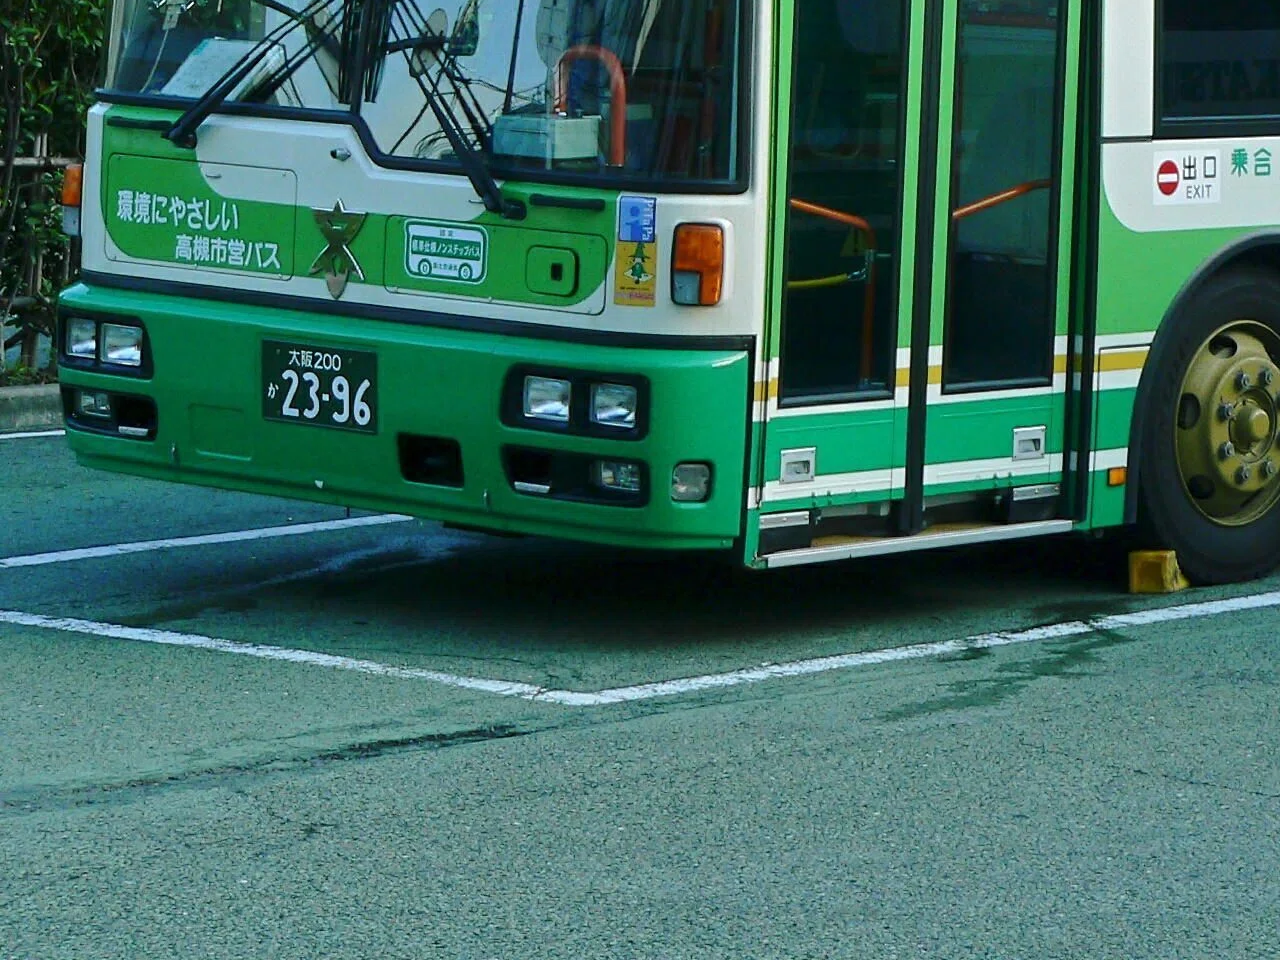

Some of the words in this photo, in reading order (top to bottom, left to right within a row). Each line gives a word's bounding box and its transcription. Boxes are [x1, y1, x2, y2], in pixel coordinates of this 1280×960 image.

[1182, 155, 1217, 180] 出口
[1230, 148, 1272, 177] 乗合
[1186, 185, 1213, 199] EXIT
[117, 190, 239, 231] 環境にやさしい
[175, 233, 281, 270] 高槻市営バス
[267, 382, 279, 399] か
[281, 369, 371, 426] 23-96
